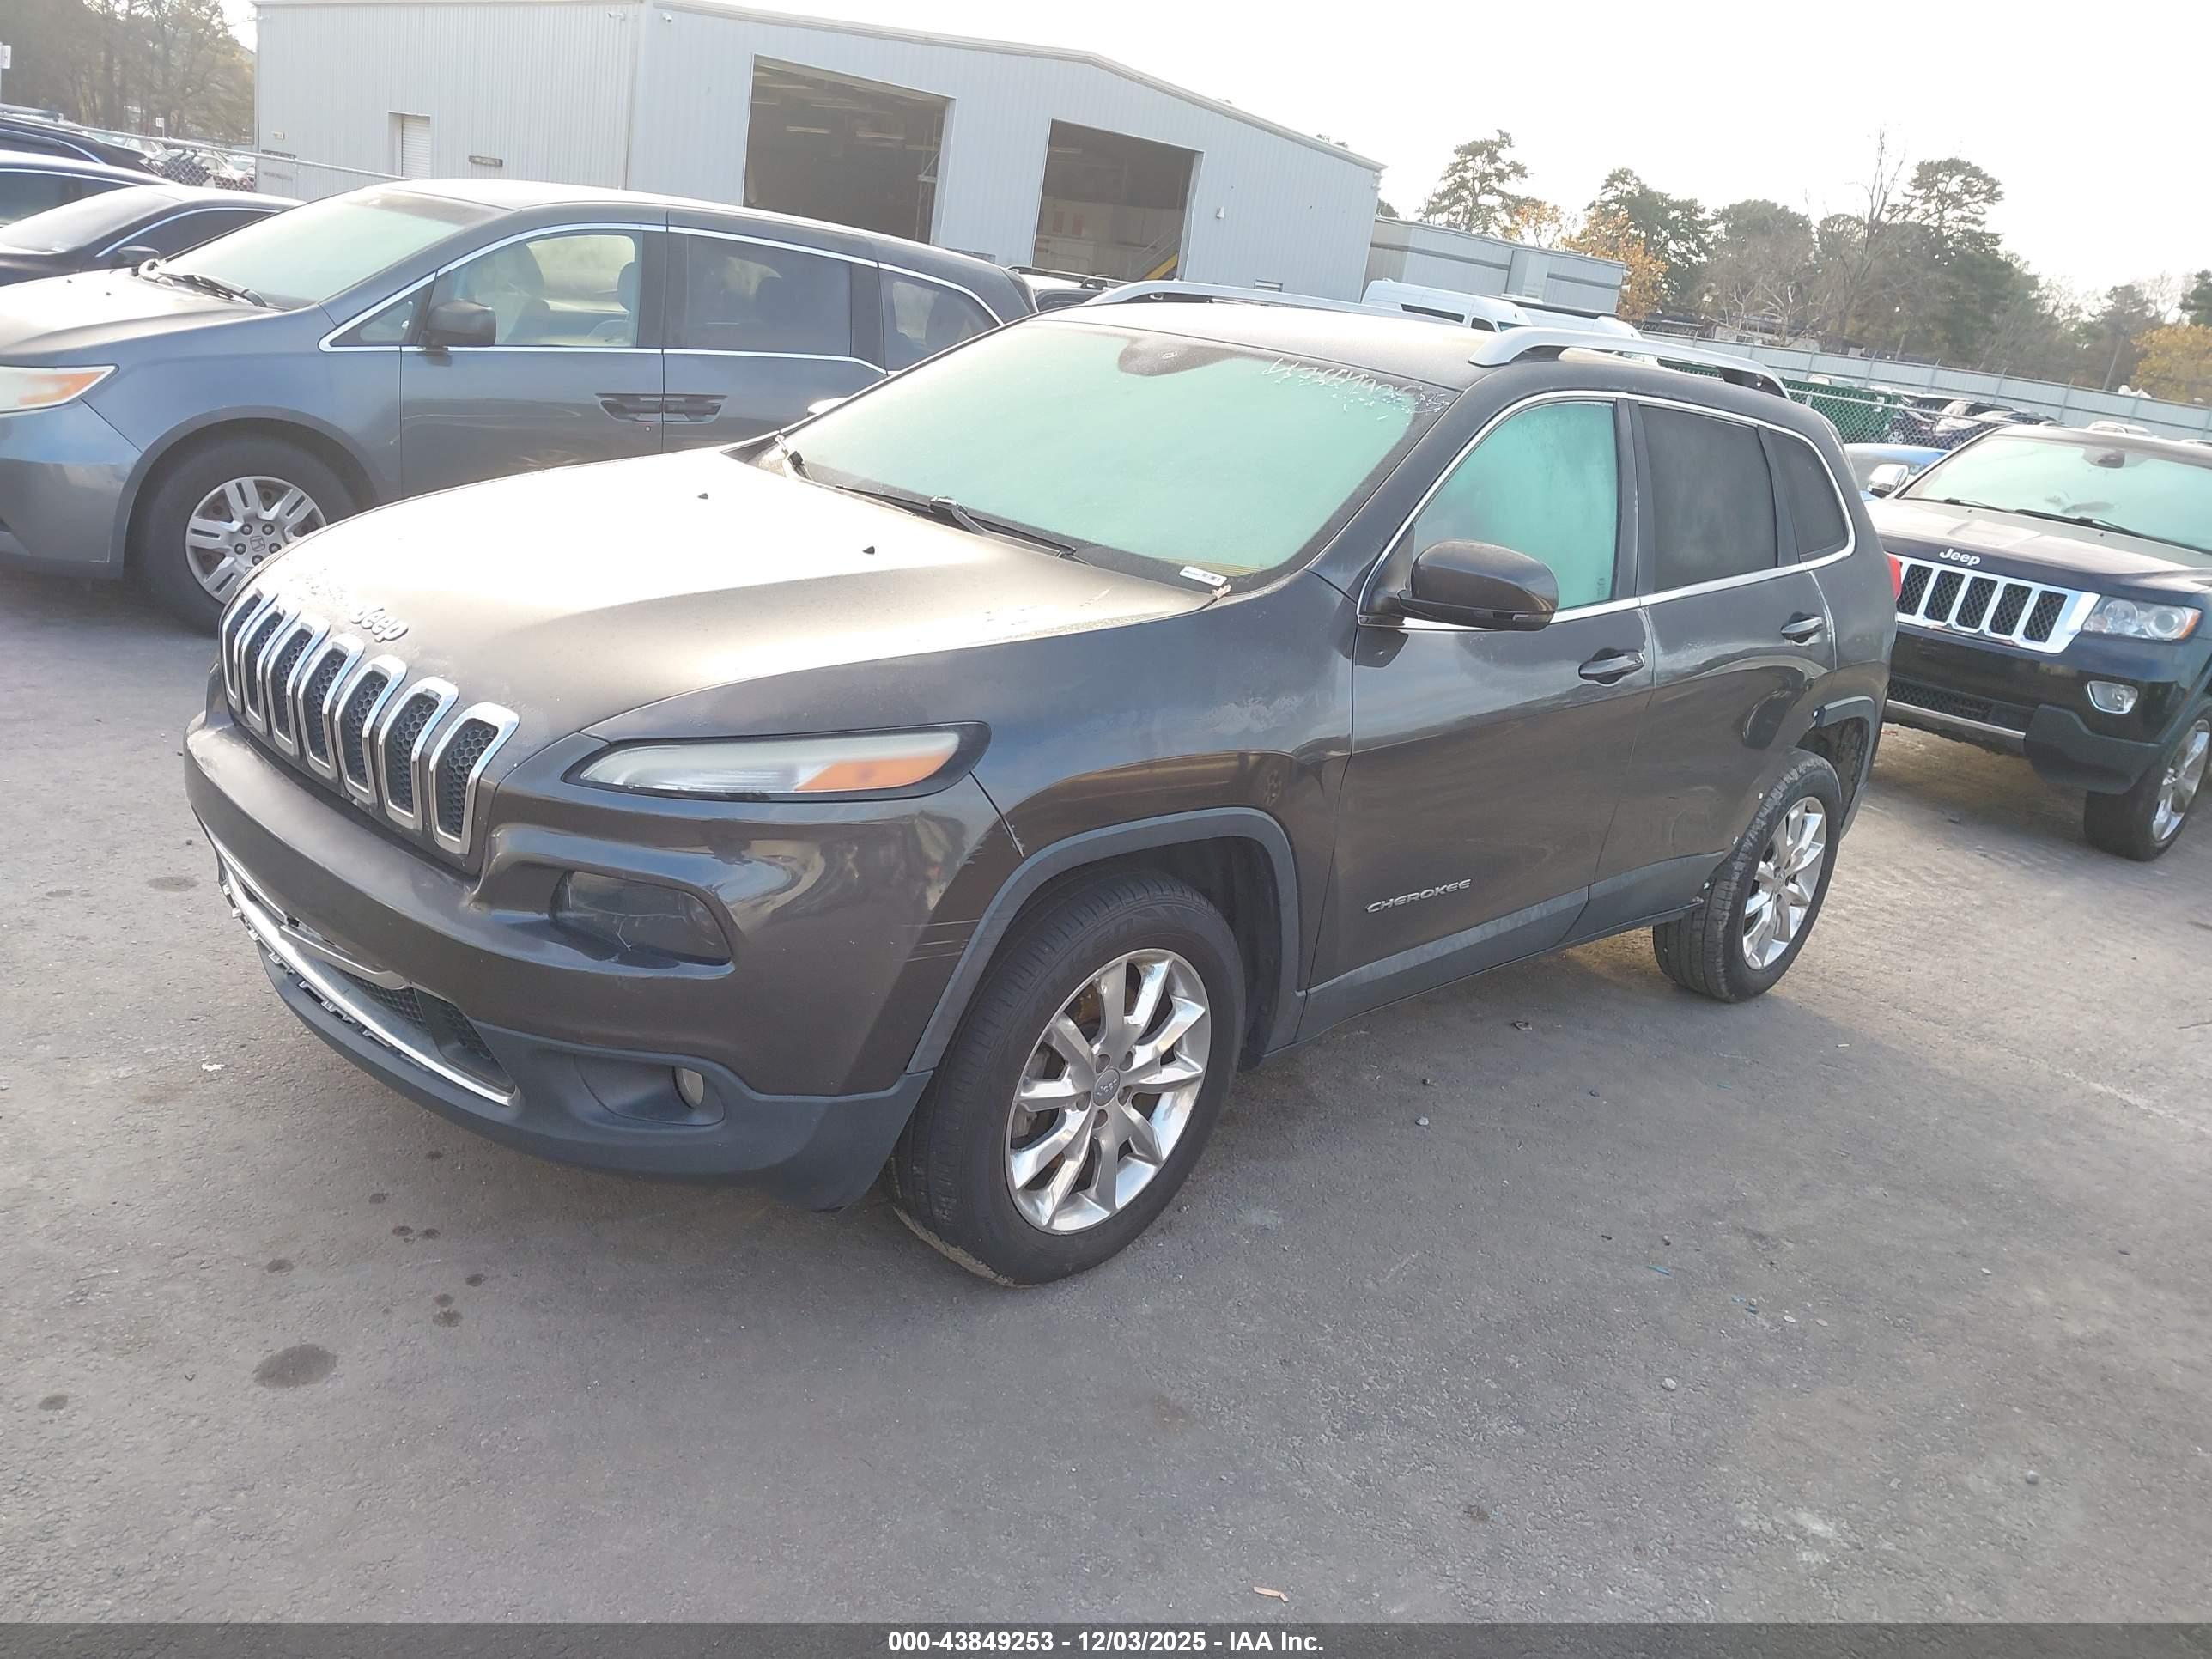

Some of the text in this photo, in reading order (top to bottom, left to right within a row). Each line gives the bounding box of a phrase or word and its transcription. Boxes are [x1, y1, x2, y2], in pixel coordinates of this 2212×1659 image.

[1939, 548, 1981, 566] Jeep
[350, 606, 409, 643] Jeep
[1366, 878, 1472, 914] CHEROKEE
